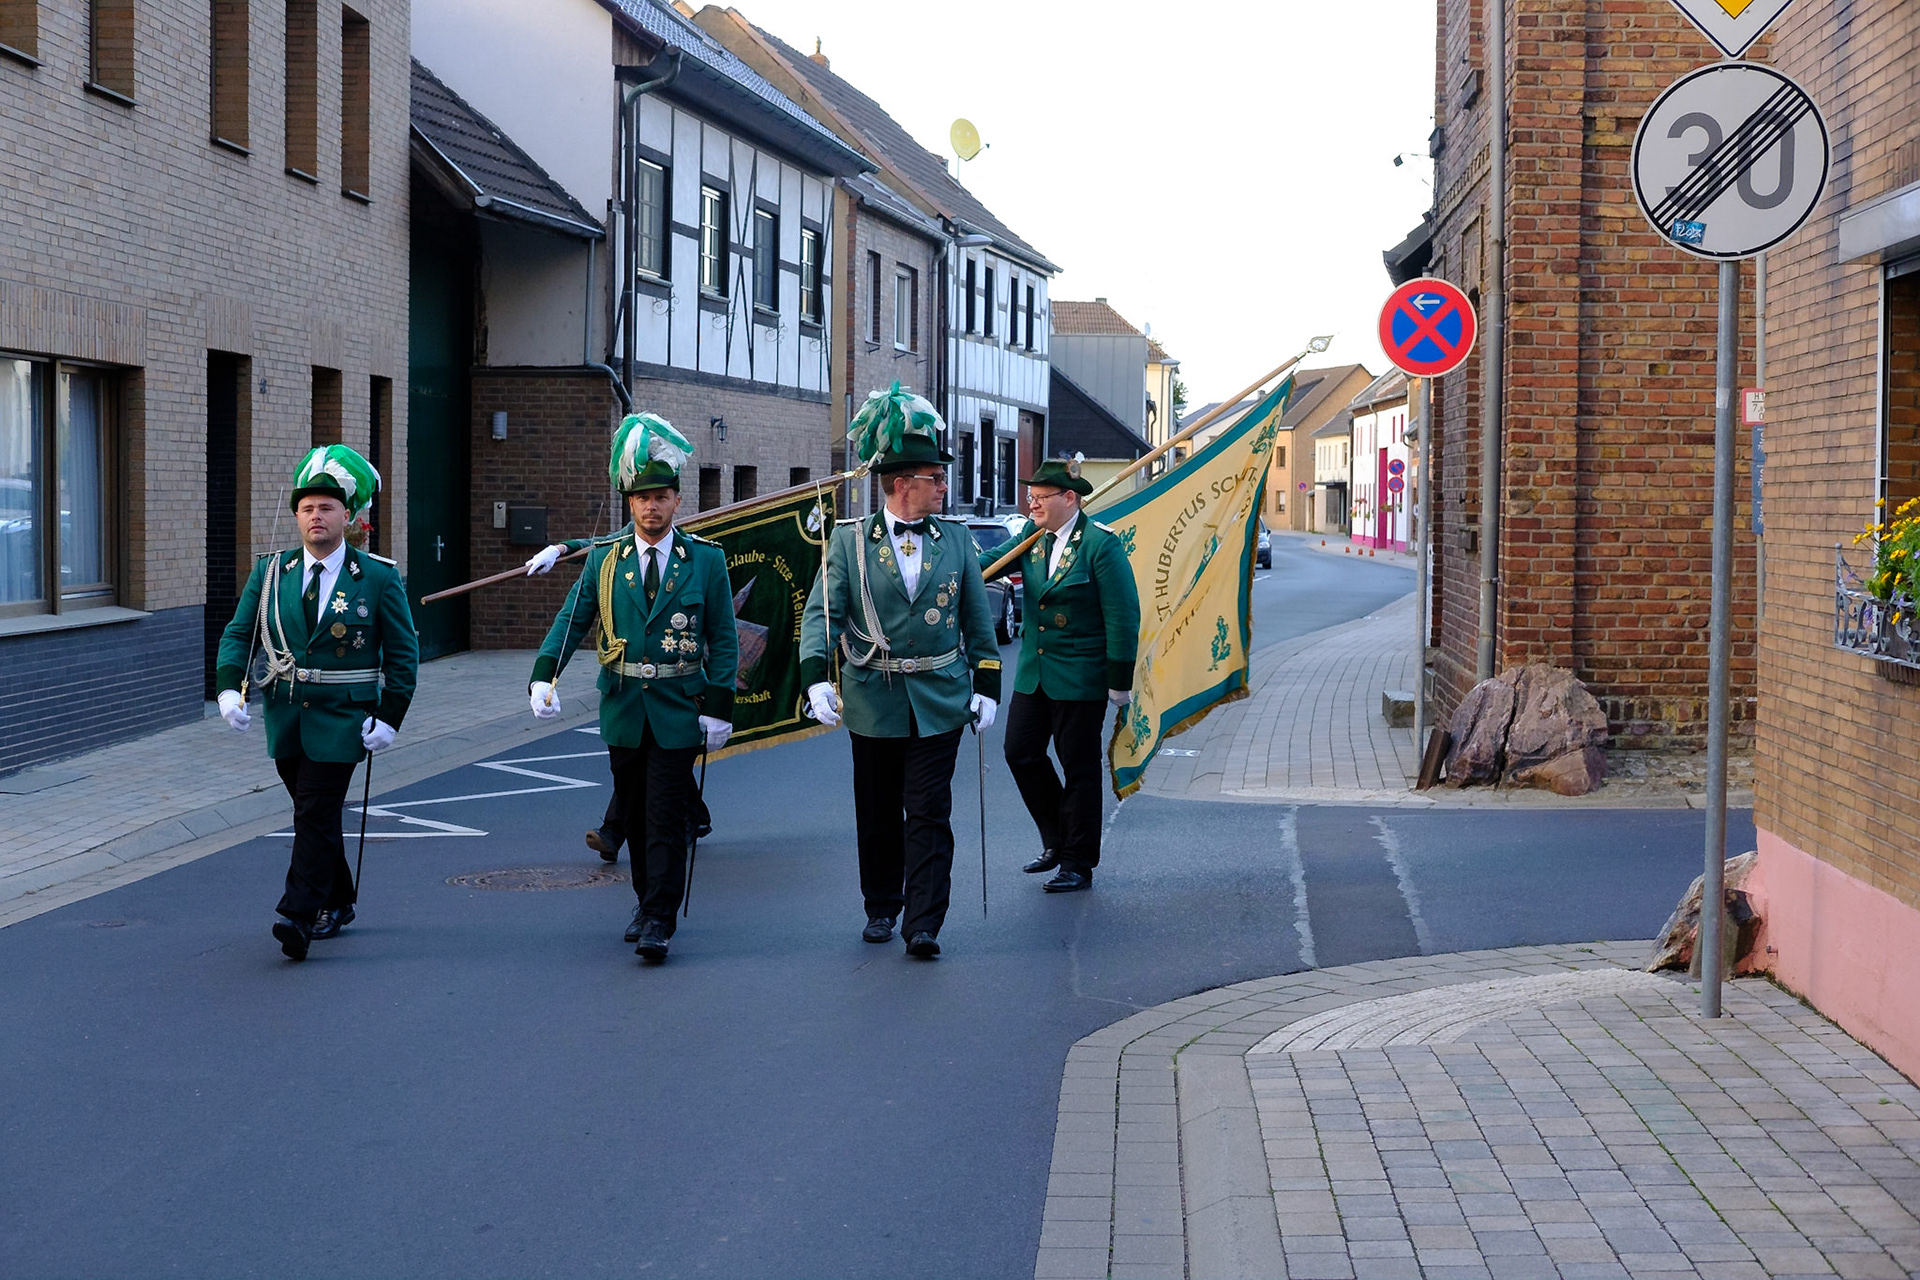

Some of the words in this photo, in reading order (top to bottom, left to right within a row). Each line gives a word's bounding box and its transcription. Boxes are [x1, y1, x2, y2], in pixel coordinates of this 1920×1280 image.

[1665, 110, 1795, 210] 30
[1155, 493, 1206, 599] HUBERTUS
[725, 549, 766, 570] Glaube
[772, 554, 794, 582] Sitte
[791, 588, 806, 643] Heimat
[735, 690, 772, 704] erschaft
